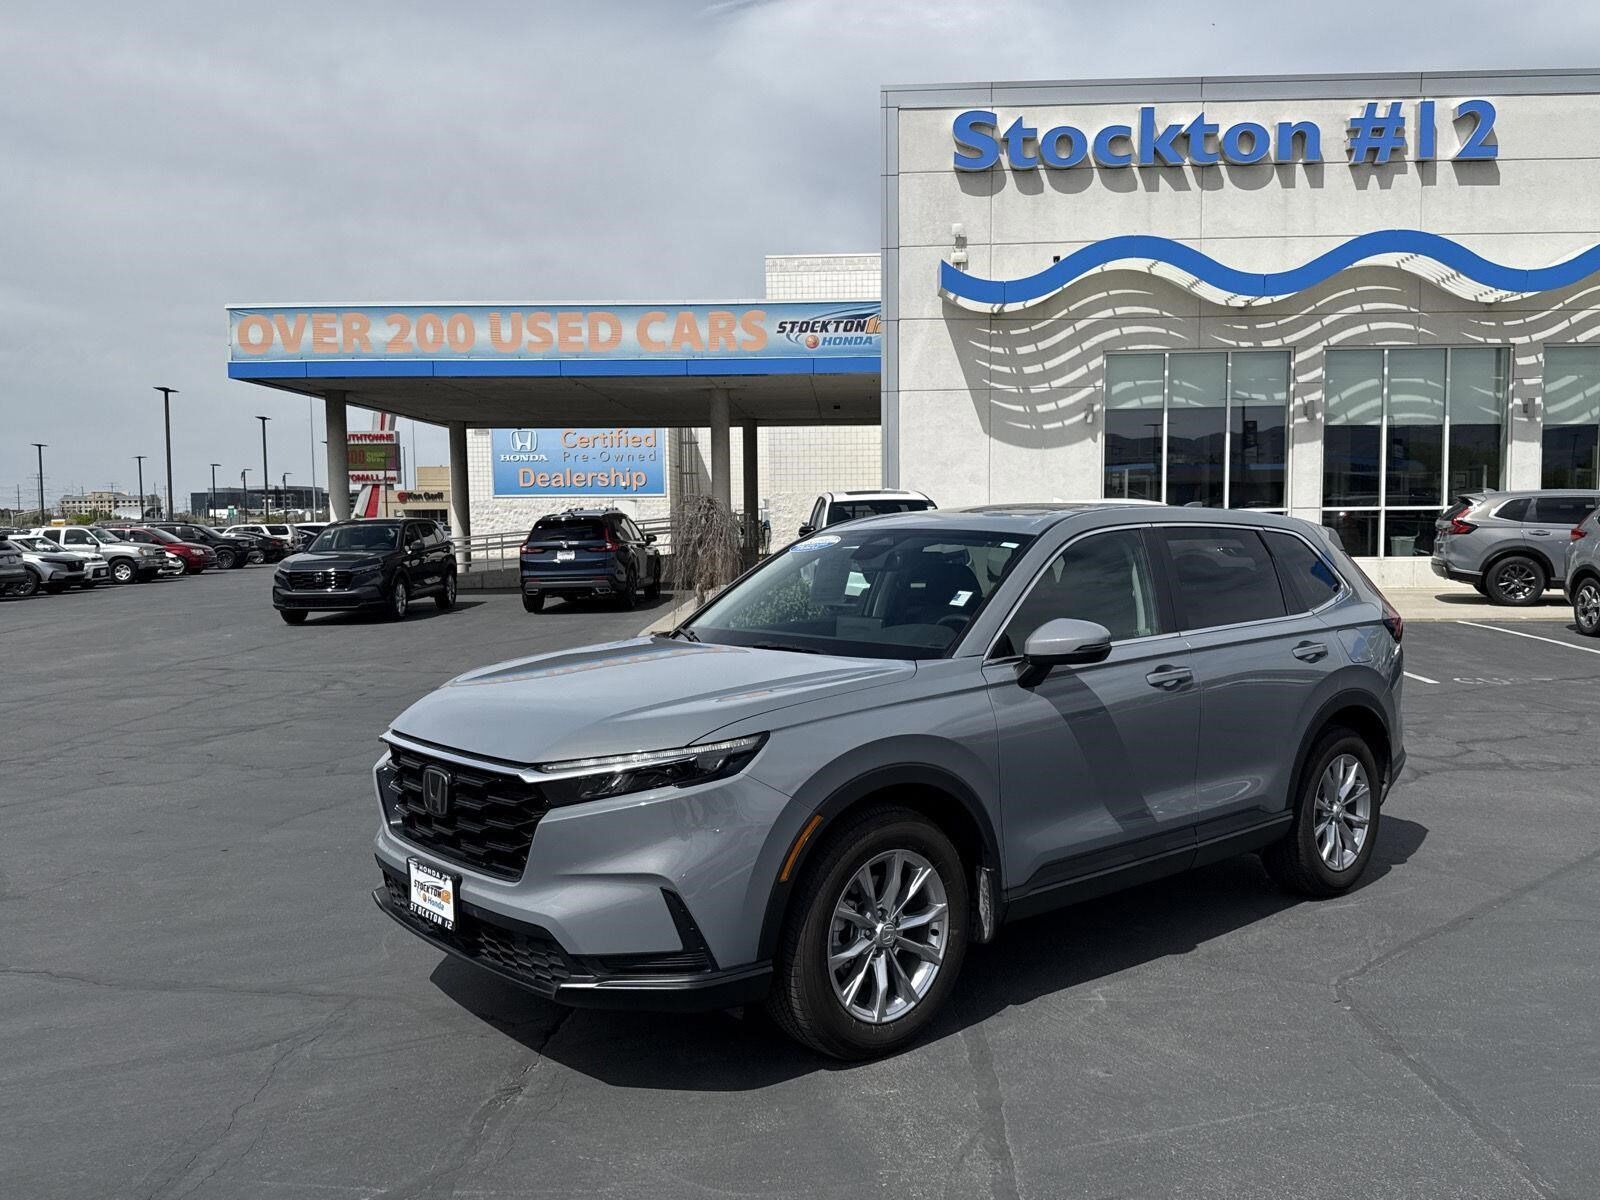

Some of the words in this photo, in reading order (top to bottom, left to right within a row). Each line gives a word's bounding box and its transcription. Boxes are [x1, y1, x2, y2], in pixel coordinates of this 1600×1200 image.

[952, 106, 1321, 172] Stockton
[1349, 98, 1500, 165] #12
[237, 312, 372, 355] OVER
[384, 312, 476, 354] 200
[488, 311, 623, 354] USED
[636, 309, 768, 352] CARS
[776, 319, 867, 334] STOCKTON
[821, 336, 873, 346] HONDA
[561, 428, 657, 449] Certified
[499, 454, 549, 463] HONDA
[563, 450, 657, 463] Pre-Owned
[518, 467, 648, 492] Dealership
[419, 864, 440, 879] HONDA
[414, 879, 442, 898] STOCKTON
[427, 895, 445, 911] Honda
[410, 902, 443, 925] STOCKTON
[444, 919, 453, 930] 12
